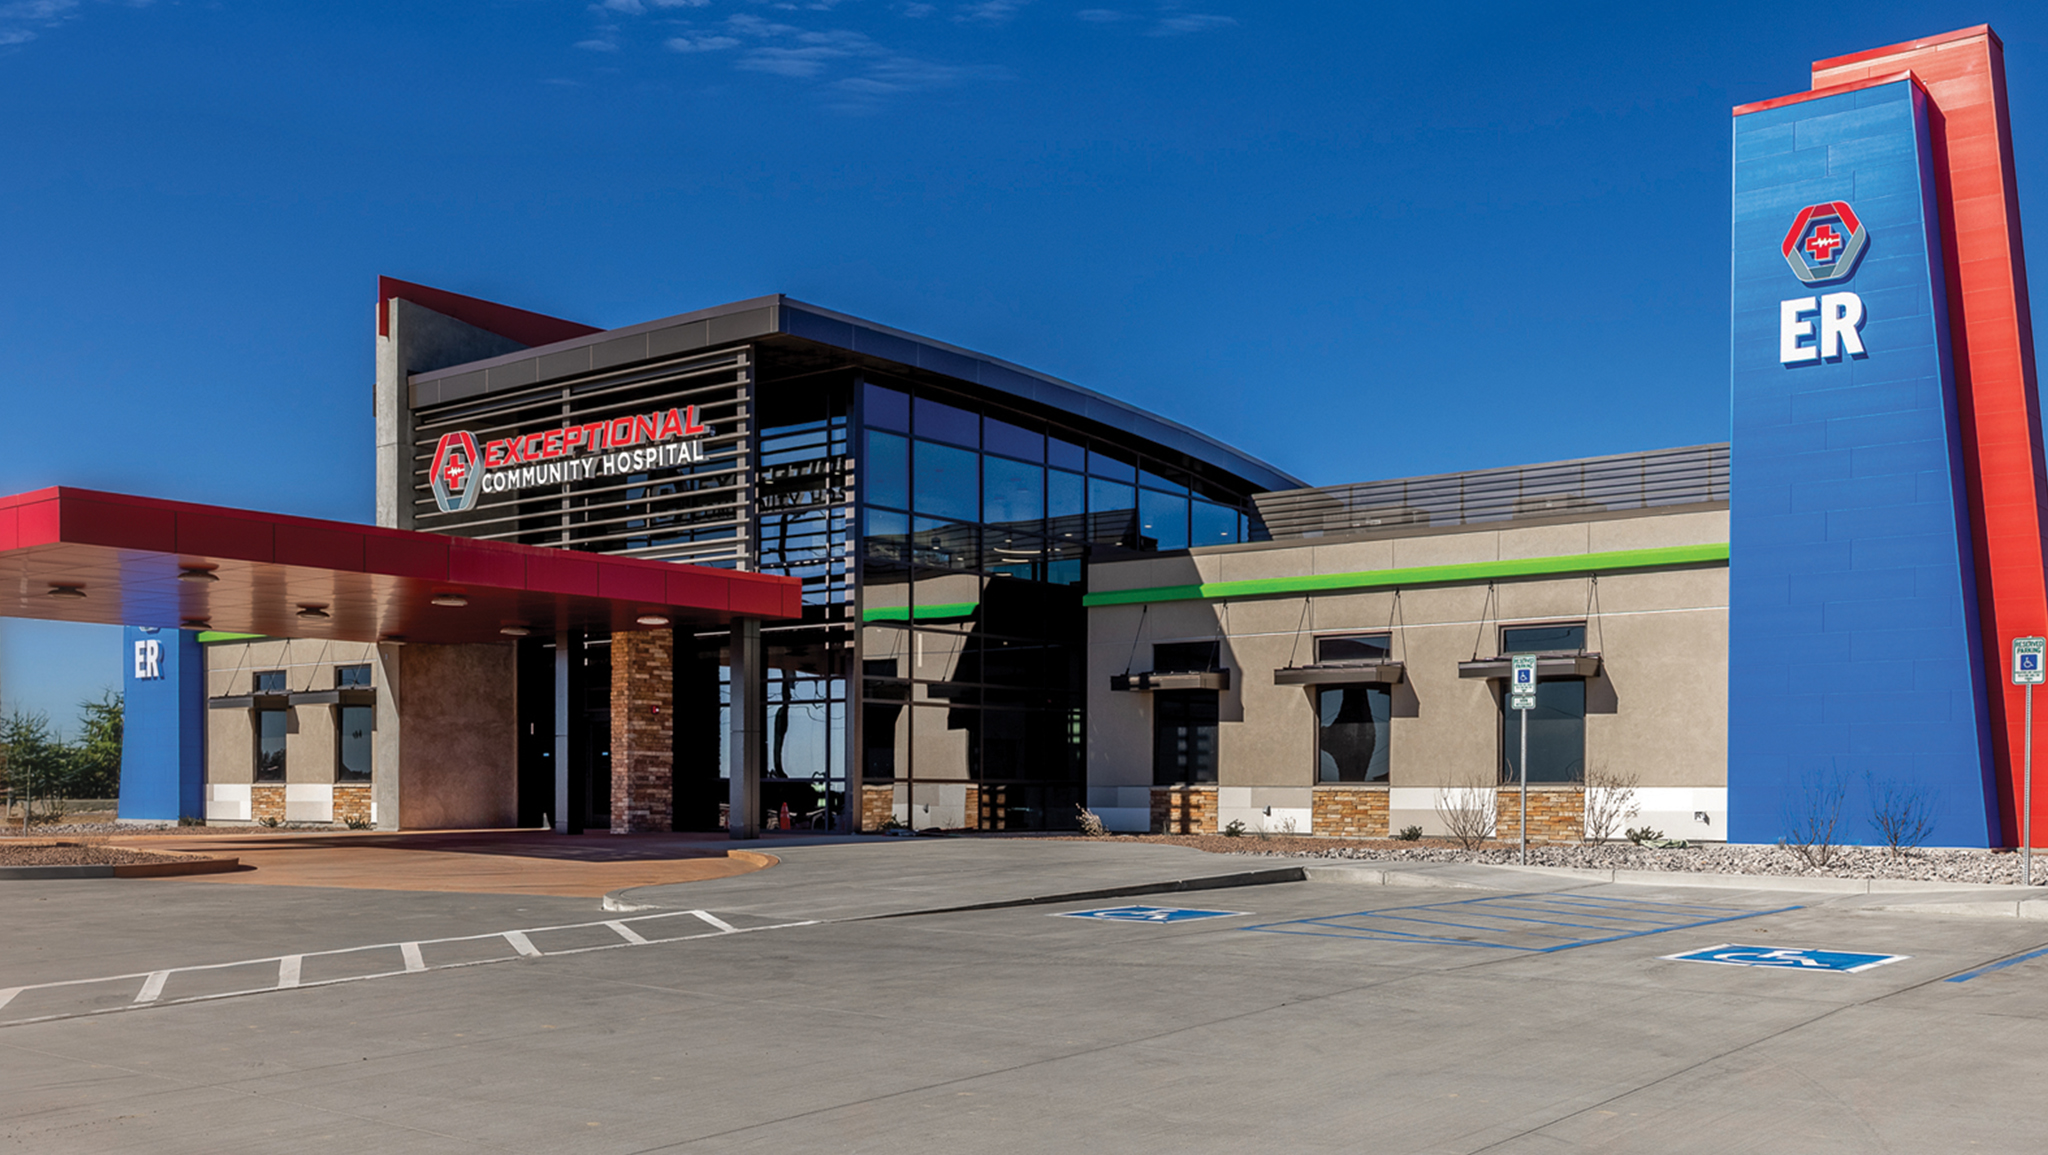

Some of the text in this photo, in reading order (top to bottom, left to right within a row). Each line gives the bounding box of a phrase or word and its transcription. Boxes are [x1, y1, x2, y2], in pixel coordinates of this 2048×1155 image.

[1780, 291, 1865, 363] ER
[484, 404, 704, 468] EXCEPTIONAL
[482, 440, 704, 493] COMMUNITY HOSPITAL
[135, 639, 159, 678] ER
